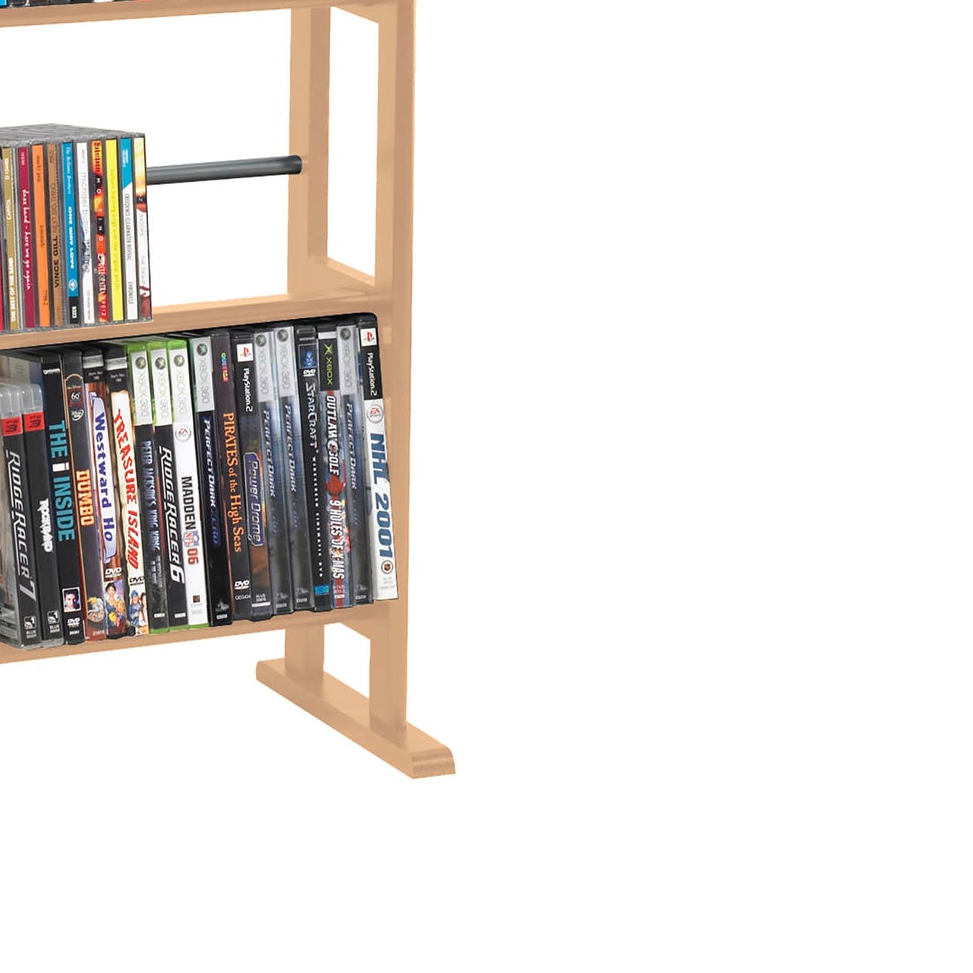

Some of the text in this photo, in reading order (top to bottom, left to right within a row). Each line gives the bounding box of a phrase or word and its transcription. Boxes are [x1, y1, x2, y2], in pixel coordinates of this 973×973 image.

[52, 260, 60, 288] VINCE
[48, 420, 68, 458] THE
[76, 469, 94, 526] DUMBO
[94, 413, 114, 542] Westward Ho
[113, 407, 140, 570] TREASURE ISLAND
[181, 476, 196, 530] MADDEN
[223, 412, 244, 553] PIRATES of the High Seas
[248, 460, 260, 500] Power
[370, 432, 393, 559] NHL 2001
[54, 476, 75, 542] INSIDE
[169, 563, 185, 584] 6
[187, 547, 199, 565] 06
[19, 579, 37, 602] 7
